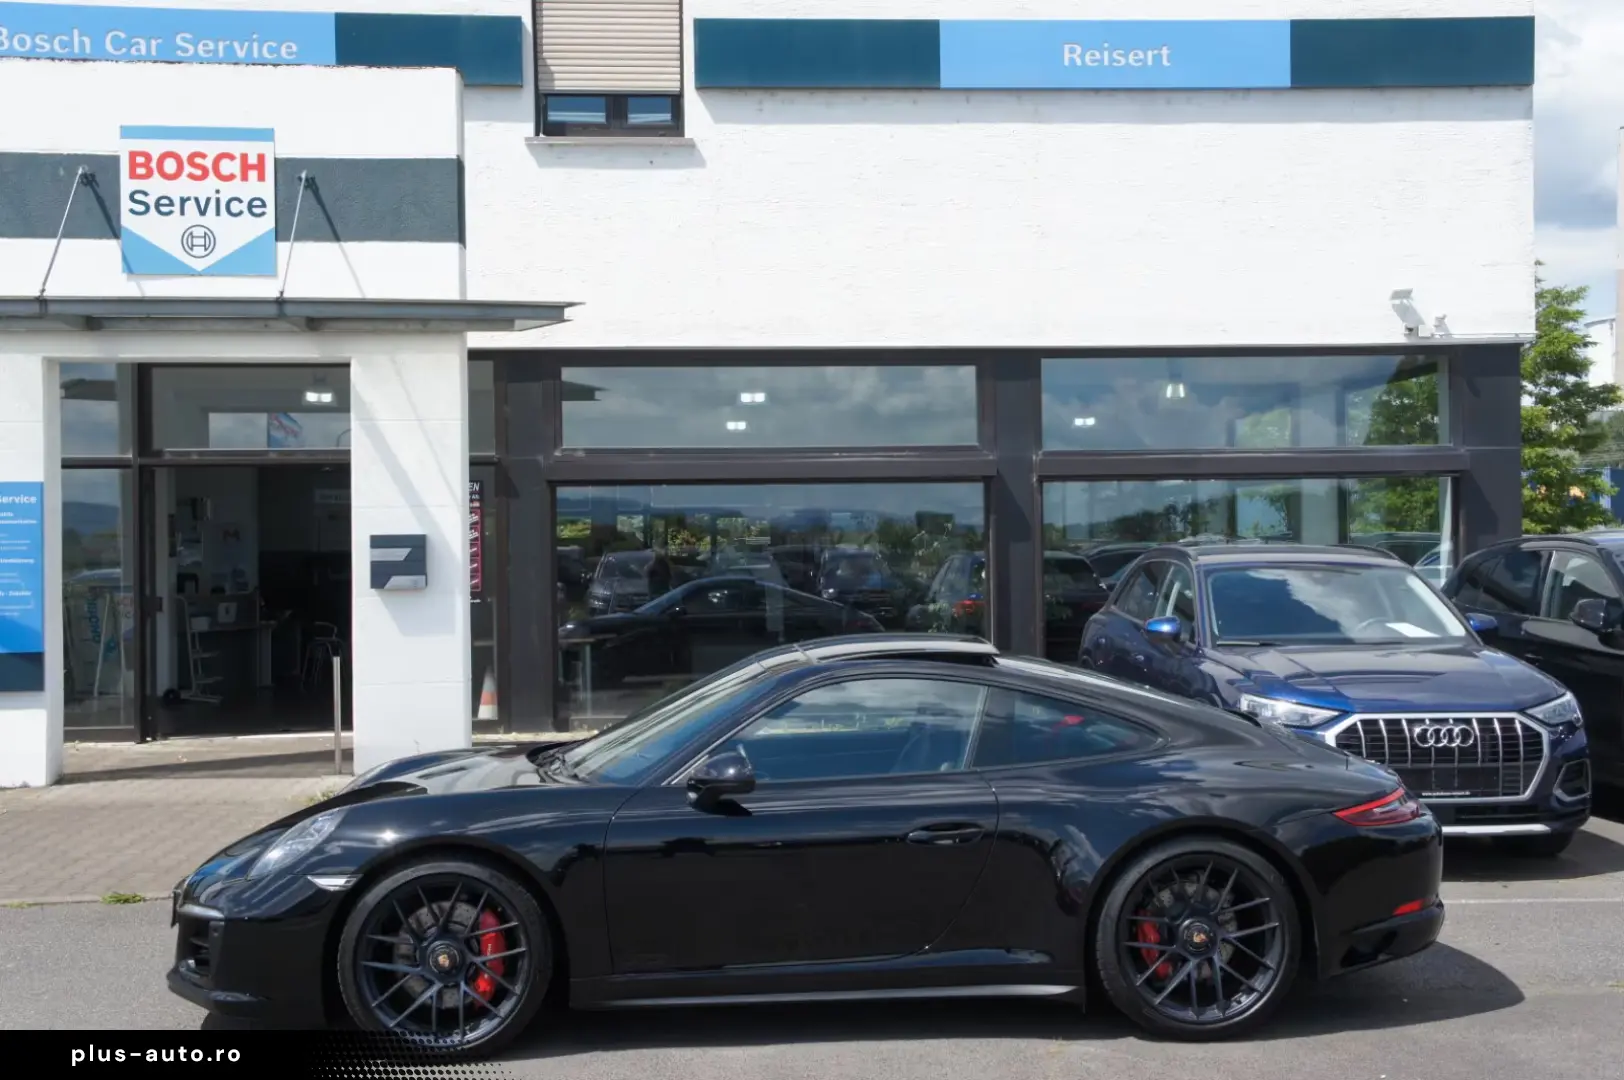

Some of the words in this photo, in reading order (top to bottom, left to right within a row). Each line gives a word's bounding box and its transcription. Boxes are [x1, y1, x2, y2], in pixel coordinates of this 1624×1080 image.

[104, 31, 163, 57] Car
[175, 32, 299, 60] Service
[1063, 42, 1171, 67] Reisert
[128, 150, 266, 182] BOSCH
[128, 189, 267, 218] Service
